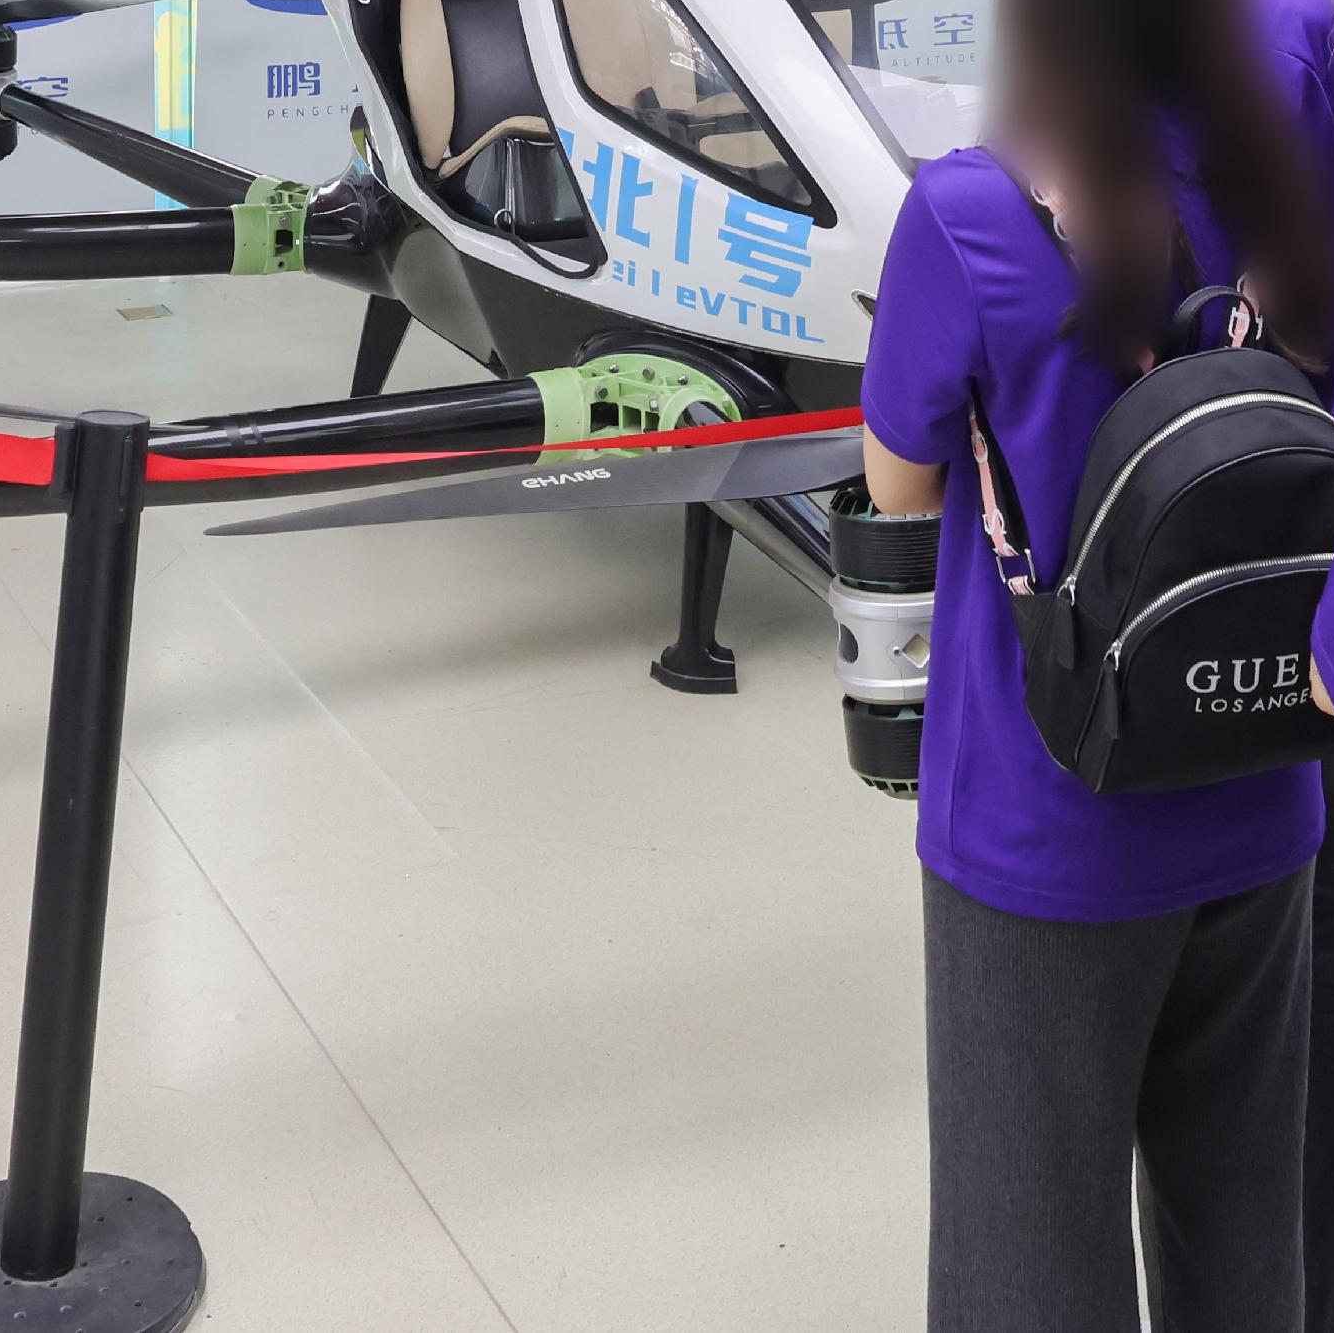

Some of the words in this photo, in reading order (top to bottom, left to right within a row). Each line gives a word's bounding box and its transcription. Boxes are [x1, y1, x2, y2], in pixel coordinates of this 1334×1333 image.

[891, 52, 976, 67] ALTITUDE
[676, 284, 825, 344] eVTOL
[1194, 697, 1244, 713] LOS
